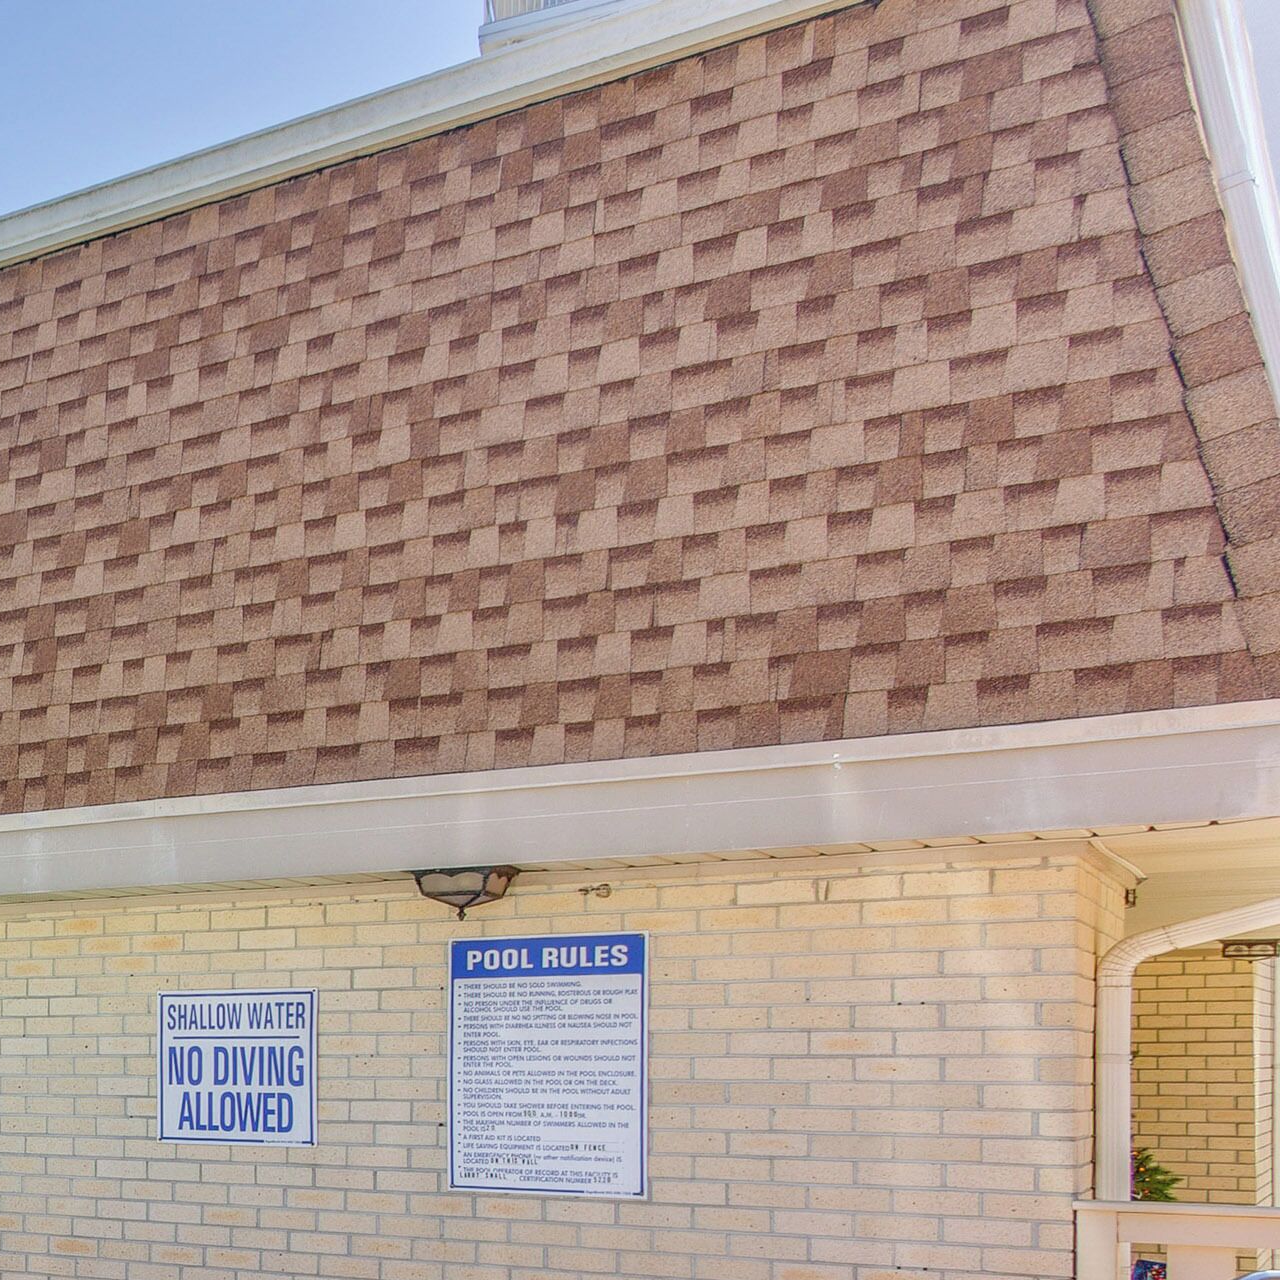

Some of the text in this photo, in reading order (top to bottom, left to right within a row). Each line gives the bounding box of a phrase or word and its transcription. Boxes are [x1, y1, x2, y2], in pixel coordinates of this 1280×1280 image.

[466, 944, 629, 971] POOL RULES
[167, 1002, 306, 1030] SHALLOW WATER
[168, 1045, 304, 1087] NO DIVING
[178, 1091, 294, 1133] ALLOWED
